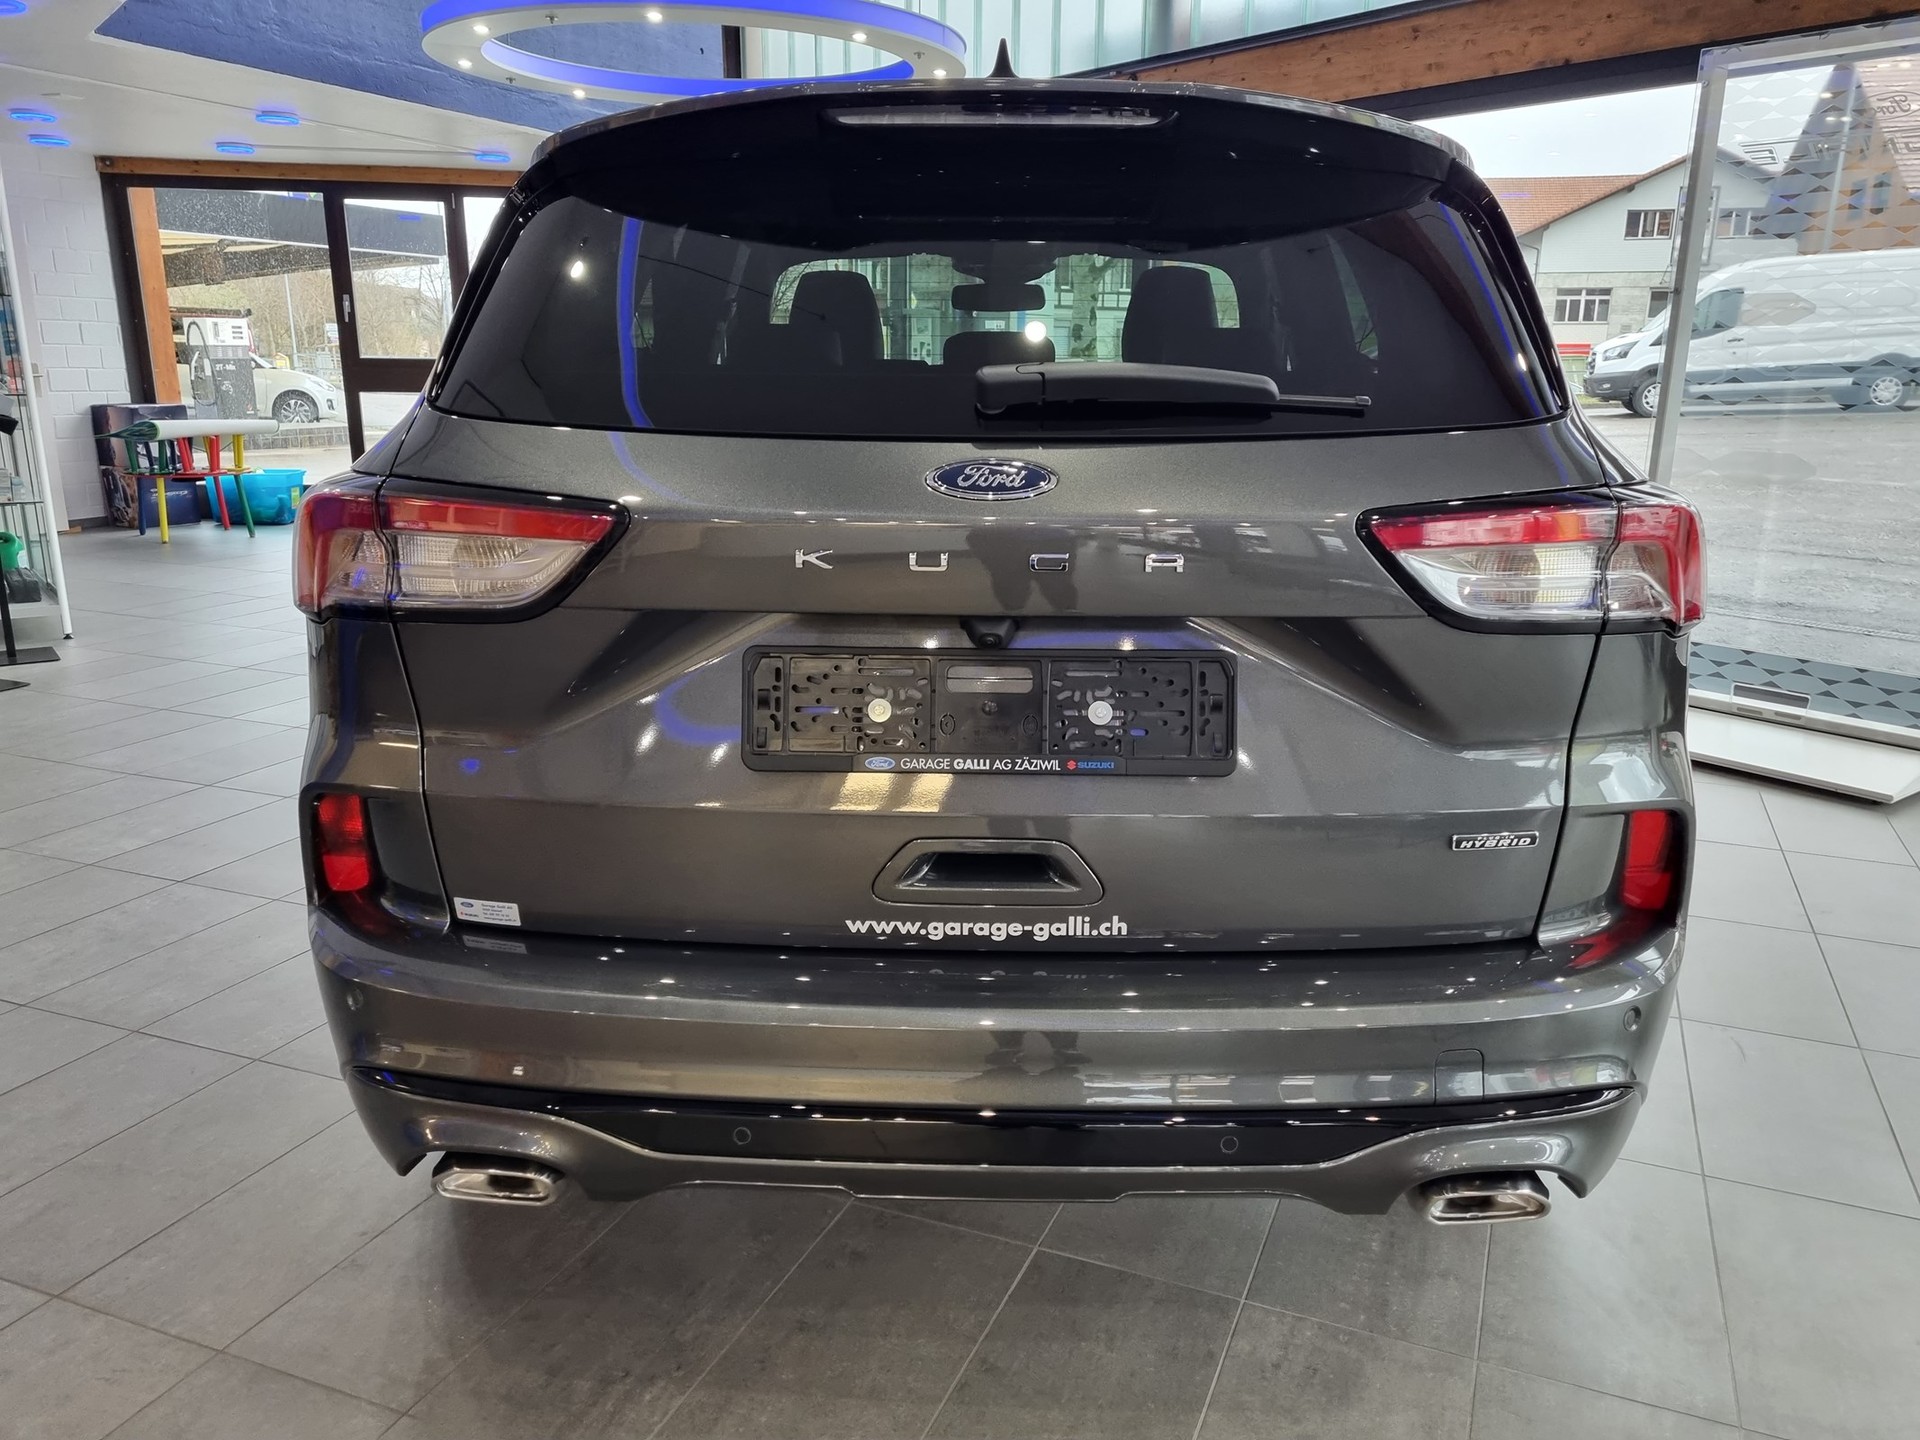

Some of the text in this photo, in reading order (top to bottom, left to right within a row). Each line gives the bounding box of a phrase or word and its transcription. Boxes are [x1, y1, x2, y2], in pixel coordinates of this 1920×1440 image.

[956, 464, 1026, 489] Ford
[795, 548, 1185, 573] KUGA
[900, 756, 1061, 771] GARAGE GALLI AG ZÄZIWIL
[1077, 761, 1115, 769] SUZUKI
[1460, 837, 1531, 849] HYBRID
[845, 915, 1128, 942] www.garage-galli.ch
